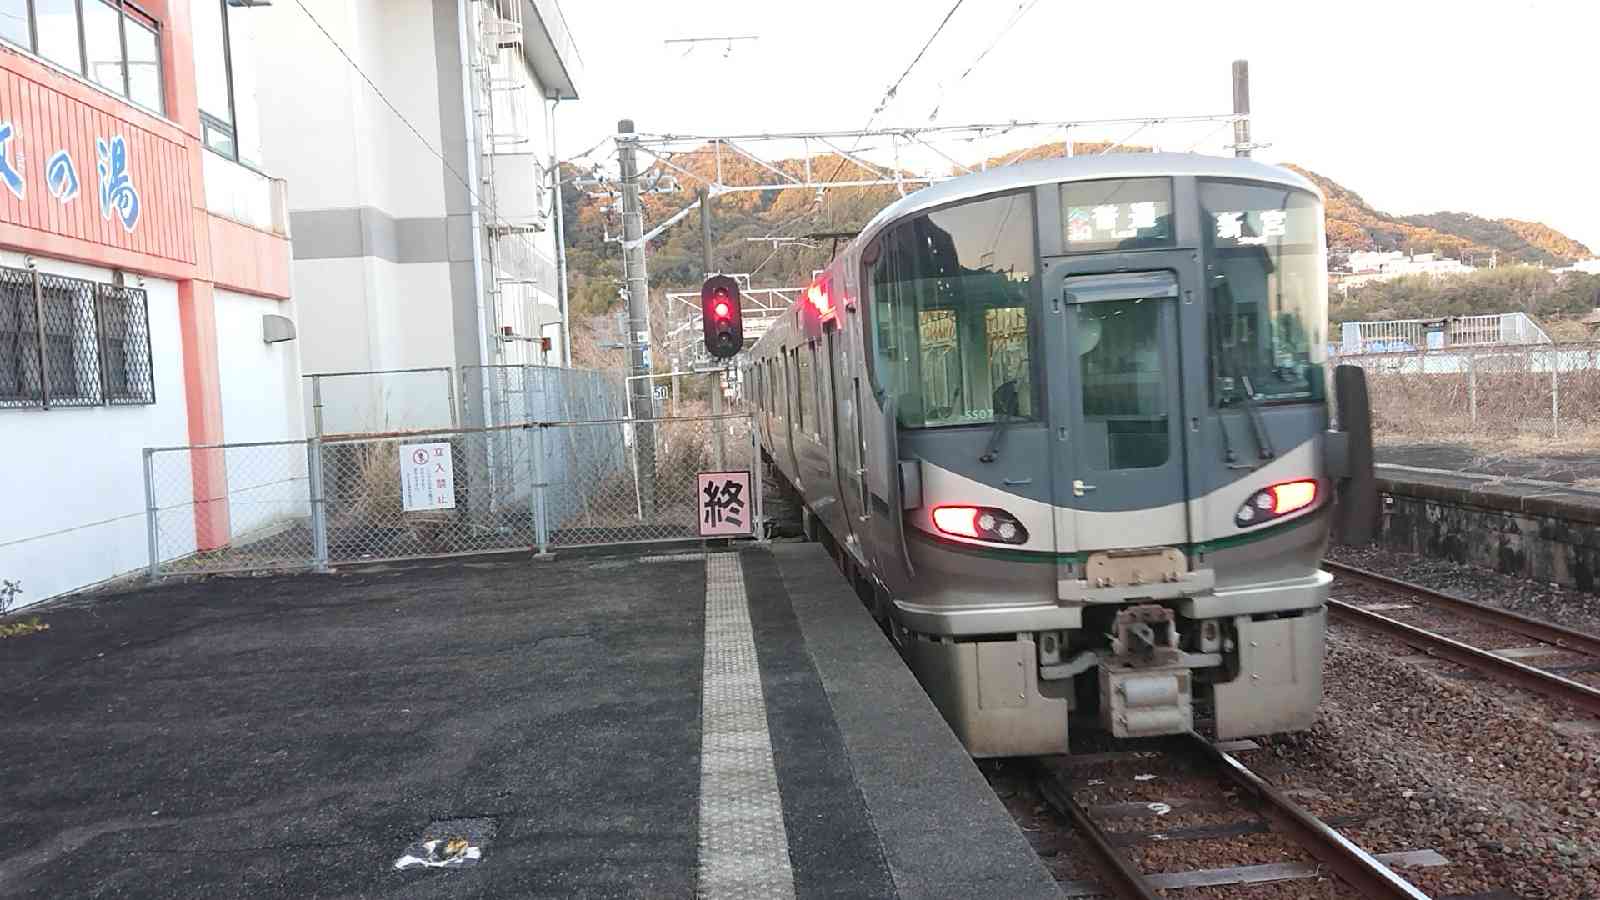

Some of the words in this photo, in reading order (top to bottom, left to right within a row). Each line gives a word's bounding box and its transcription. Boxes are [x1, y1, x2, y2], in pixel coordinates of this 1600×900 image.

[432, 447, 449, 504] 立入禁止
[703, 479, 745, 528] 終
